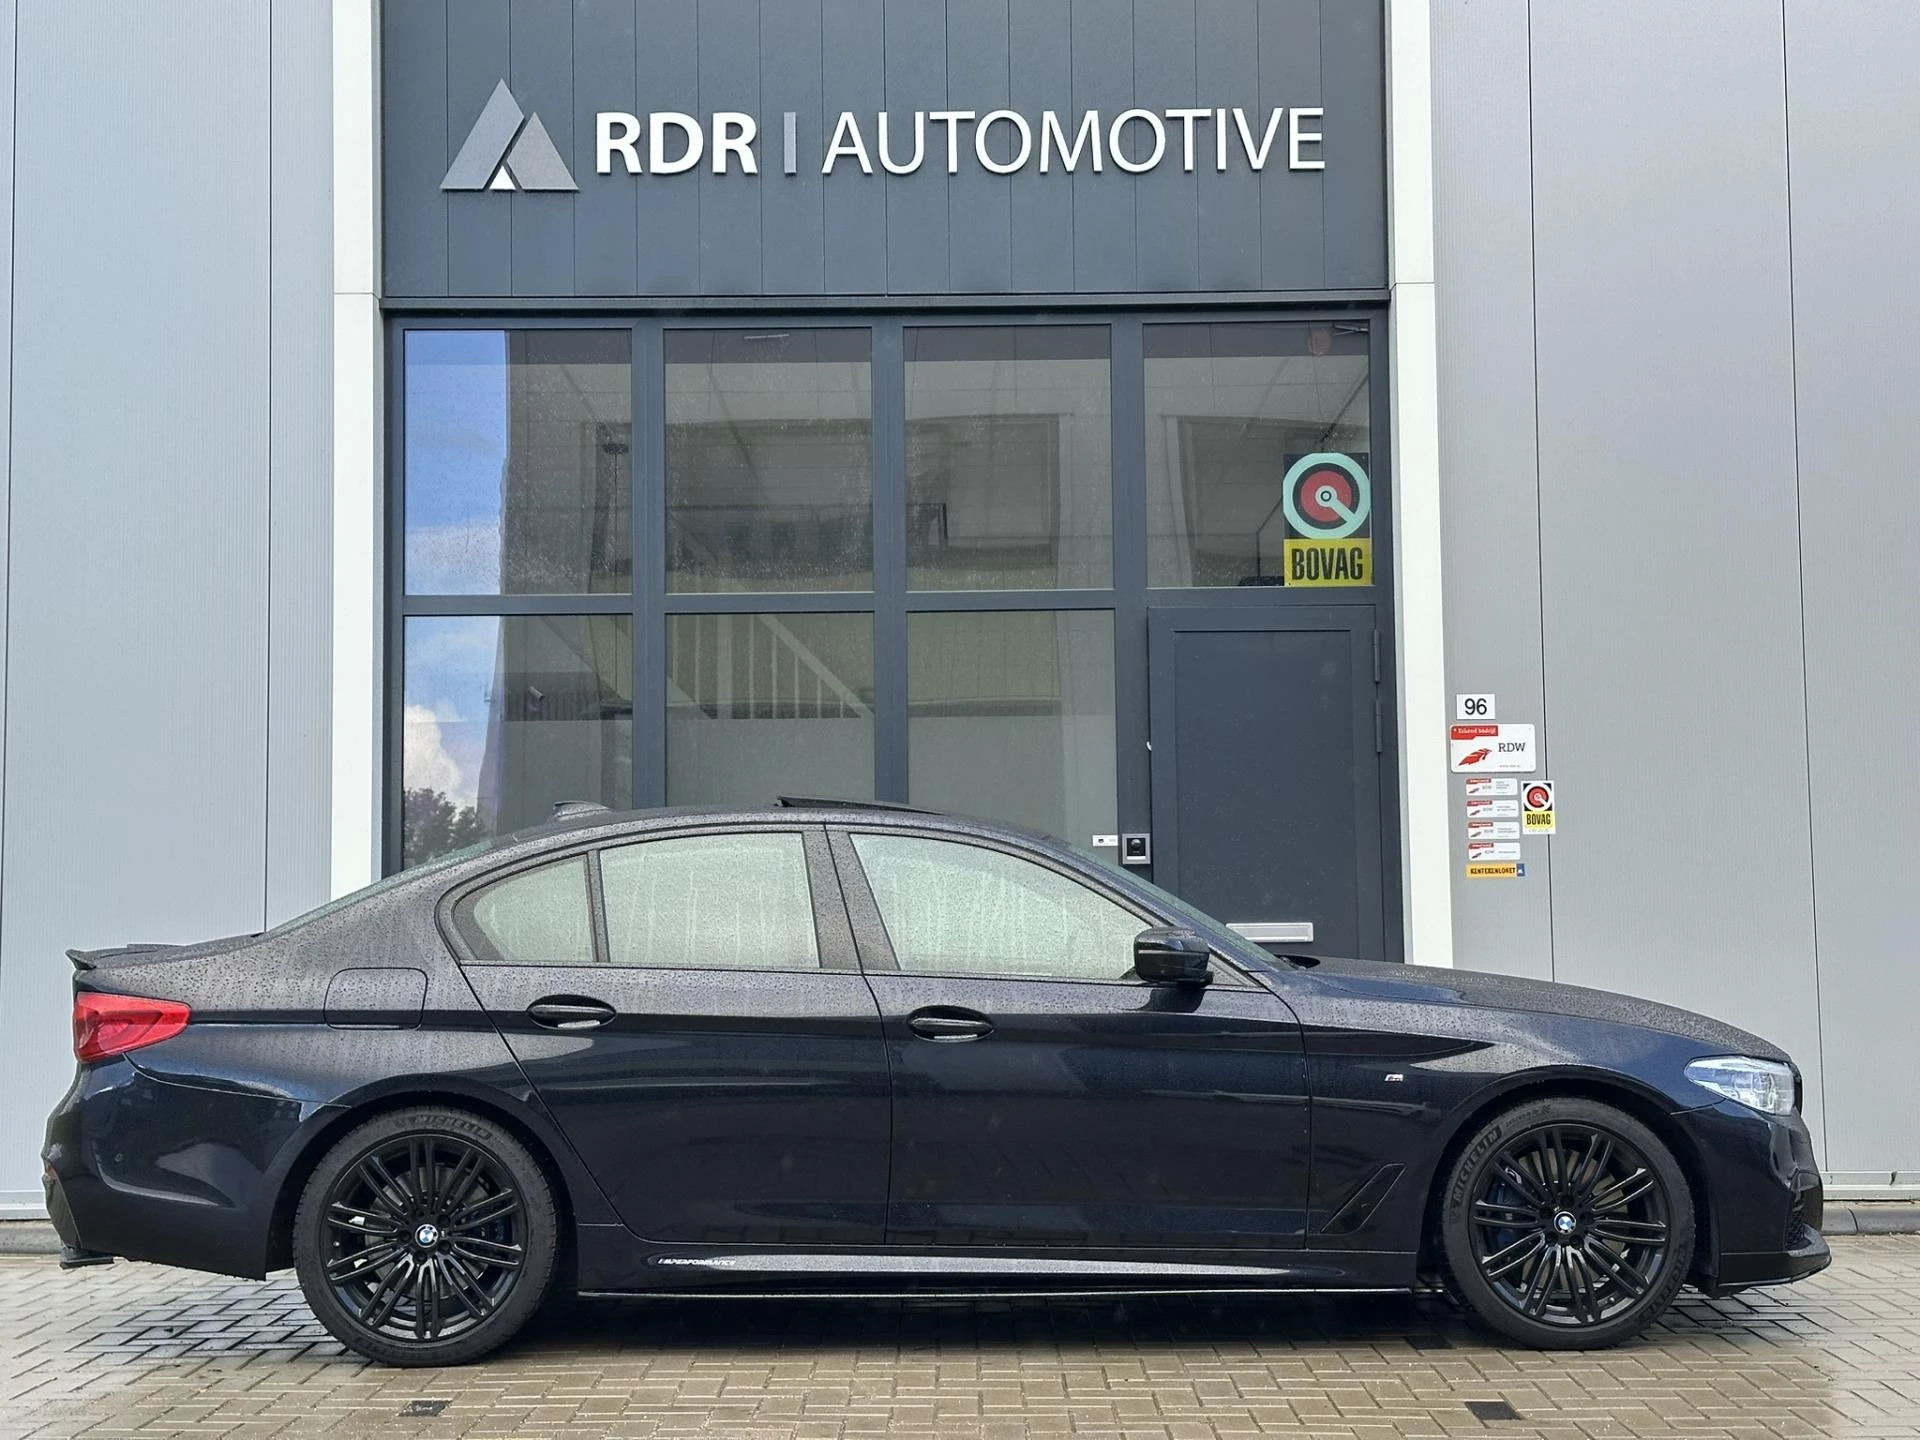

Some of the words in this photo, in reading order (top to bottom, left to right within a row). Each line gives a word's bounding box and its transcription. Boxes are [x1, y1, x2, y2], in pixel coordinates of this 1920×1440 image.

[596, 112, 758, 174] RDR
[821, 107, 1326, 175] AUTOMOTIVE
[1291, 547, 1363, 580] BOVAG
[1464, 698, 1487, 715] 96
[1498, 742, 1526, 752] RDW
[1526, 813, 1551, 825] BOVAG
[1453, 1129, 1499, 1202] MICHELIN
